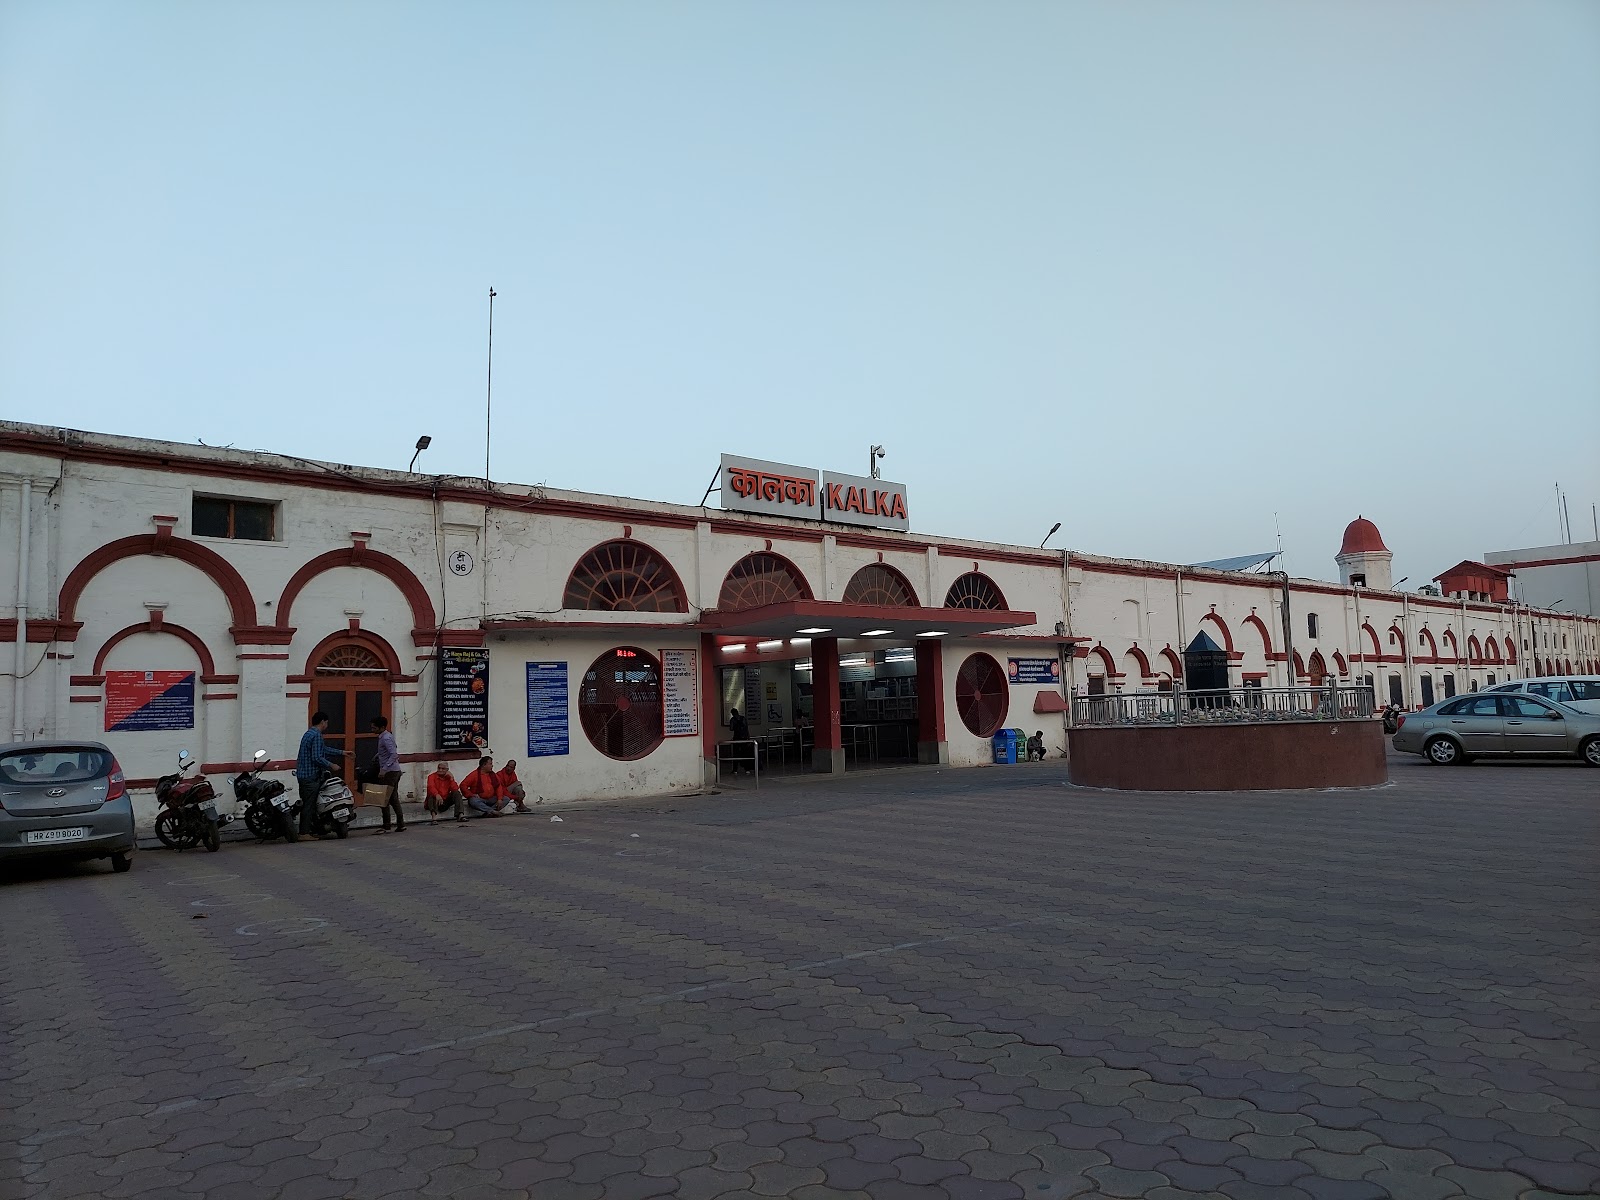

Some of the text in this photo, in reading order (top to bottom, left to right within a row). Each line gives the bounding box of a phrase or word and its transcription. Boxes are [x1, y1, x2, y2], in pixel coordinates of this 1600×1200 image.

[728, 467, 816, 506] कालका
[827, 482, 907, 519] KALKA
[455, 563, 467, 572] 96
[33, 832, 44, 841] HR
